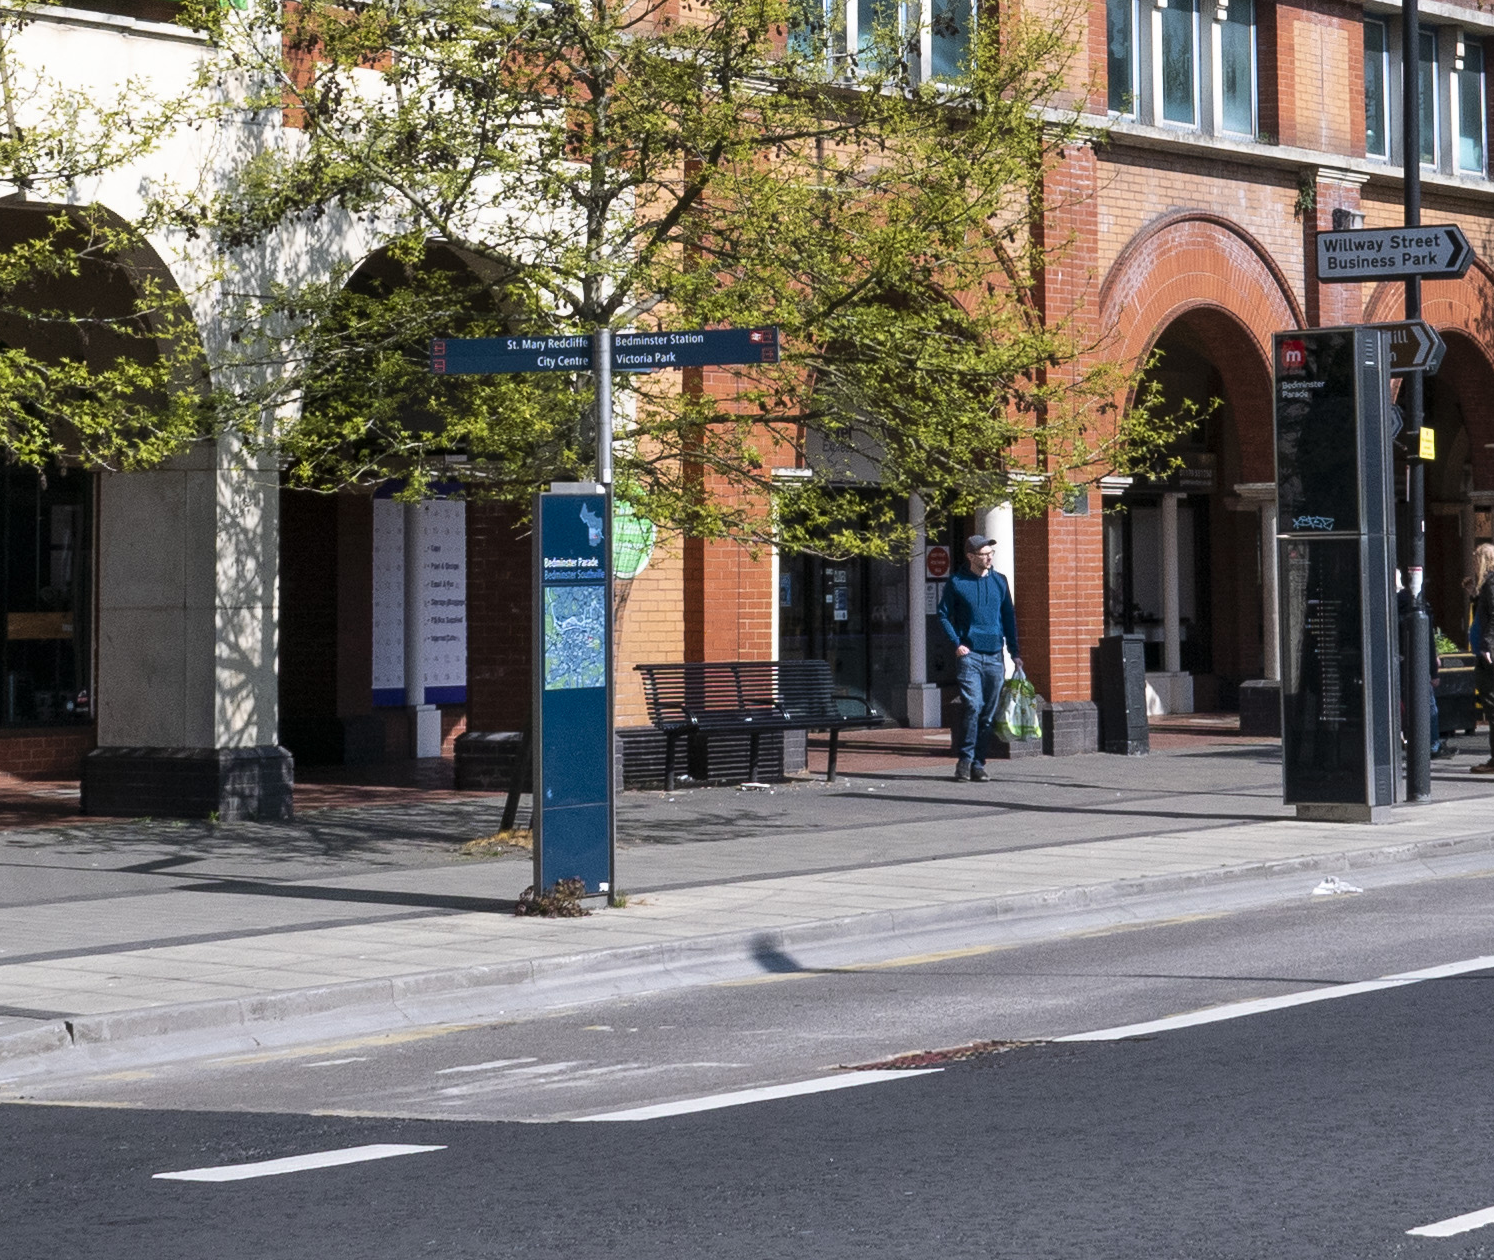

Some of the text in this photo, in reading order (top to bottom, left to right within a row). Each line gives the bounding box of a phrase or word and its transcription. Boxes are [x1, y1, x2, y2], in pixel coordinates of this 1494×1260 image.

[1323, 234, 1441, 253] Willway Street
[1327, 251, 1438, 270] Business Park
[506, 337, 589, 351] St. Mary Redcliffe
[615, 333, 704, 346] Bedminster Station
[537, 355, 589, 367] City Centre
[616, 352, 676, 364] Victoria Park
[1286, 350, 1302, 362] m
[1281, 381, 1325, 389] Bedminster
[1281, 389, 1309, 398] Parade
[544, 557, 599, 568] Bedminster Parade
[544, 569, 577, 580] Bedminster
